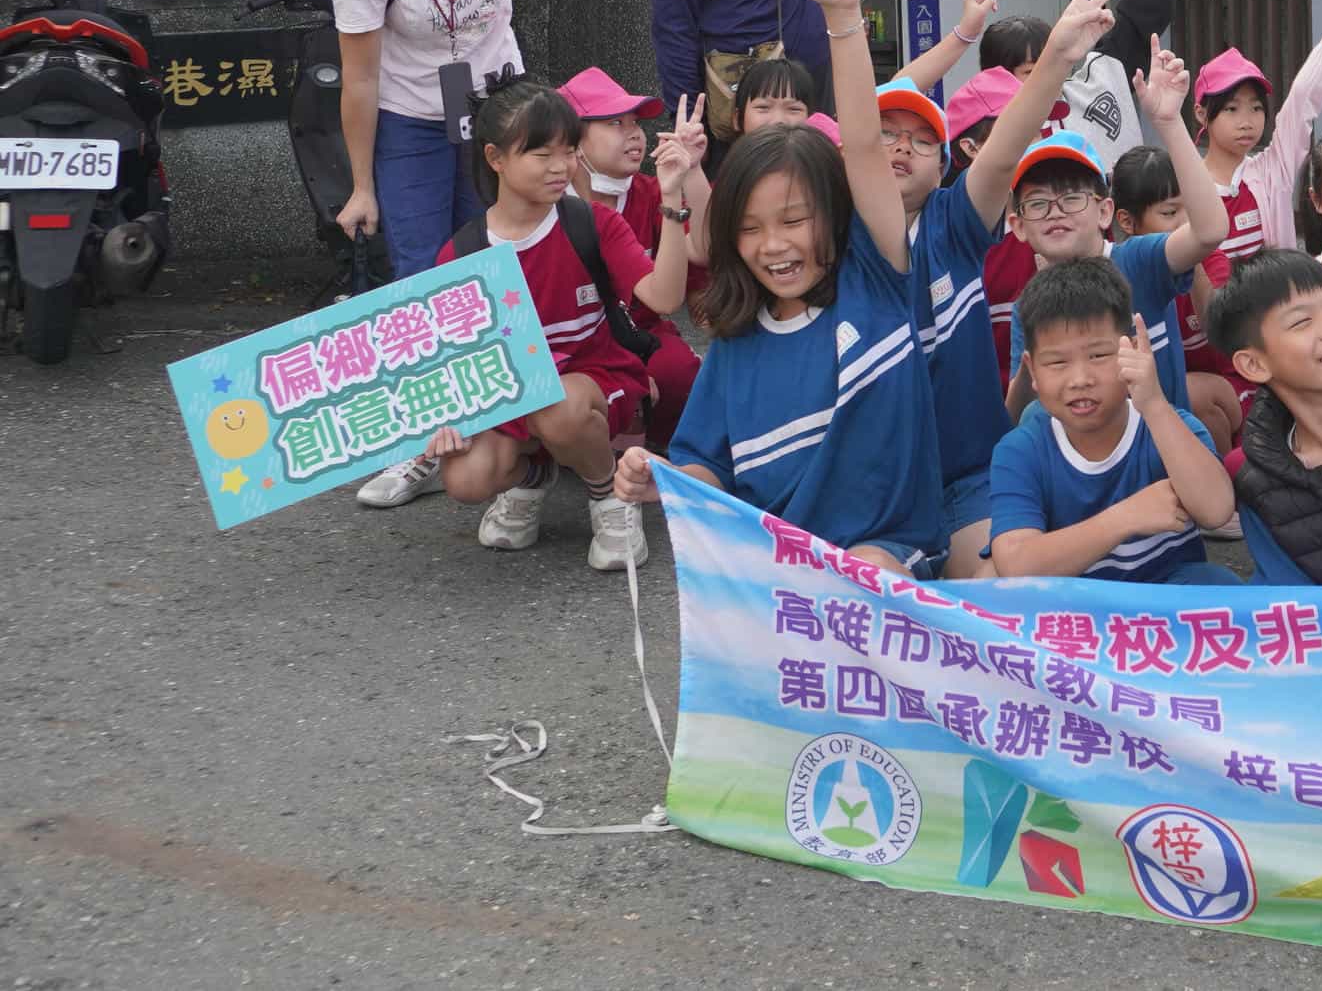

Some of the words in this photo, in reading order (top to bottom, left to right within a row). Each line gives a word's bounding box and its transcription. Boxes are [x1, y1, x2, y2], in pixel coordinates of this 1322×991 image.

[1083, 90, 1121, 141] B
[264, 281, 488, 408] 偏鄉樂學
[281, 347, 514, 472] 創意無限
[774, 590, 1223, 732] 高雄市政府教育局
[777, 658, 1174, 772] 第四區承辦學校
[791, 744, 826, 833] MINISTRY
[829, 739, 854, 754] OF
[860, 743, 915, 851] EDUCATION
[802, 835, 887, 863] 教育部
